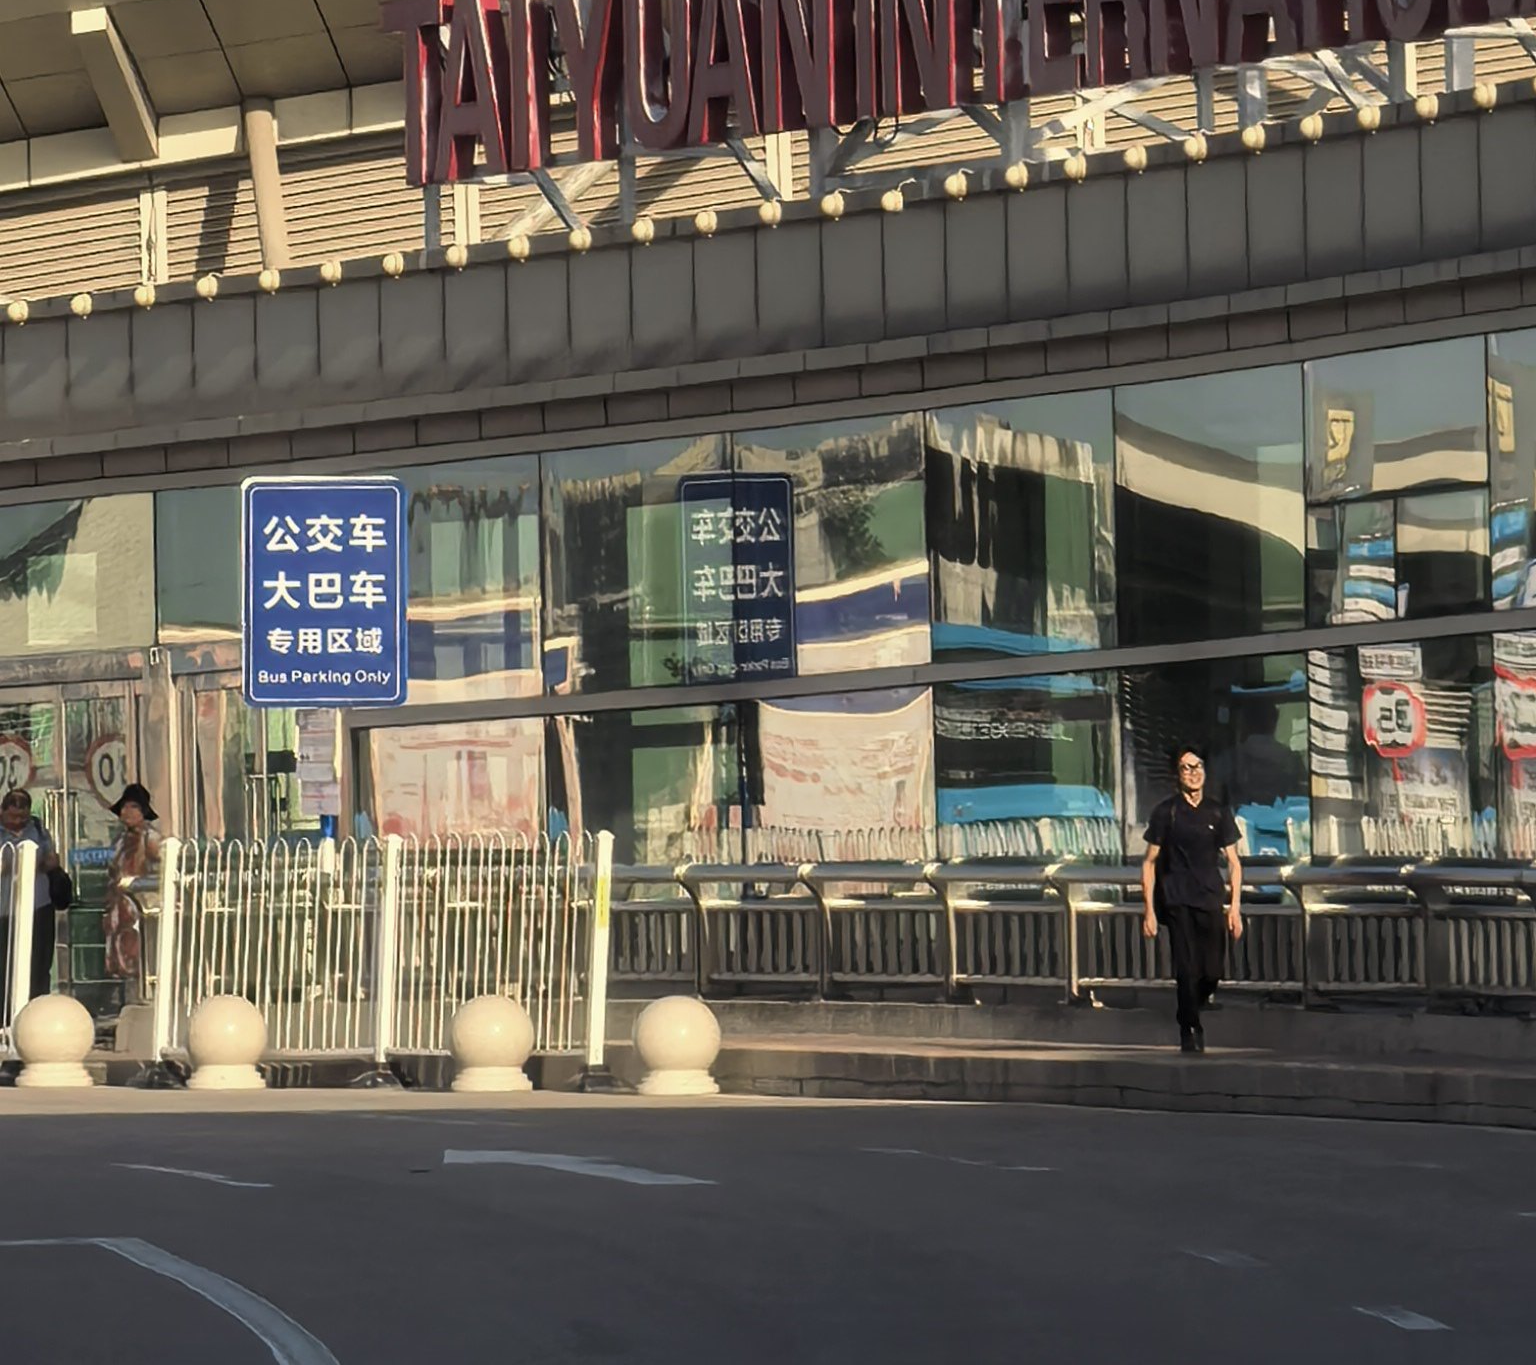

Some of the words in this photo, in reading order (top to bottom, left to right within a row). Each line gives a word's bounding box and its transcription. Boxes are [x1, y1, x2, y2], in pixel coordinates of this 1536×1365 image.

[263, 513, 388, 554] 公交车
[262, 570, 387, 610] 大巴车
[266, 627, 383, 655] 专用区域
[258, 669, 288, 684] Bus
[291, 669, 351, 686] Parking
[355, 669, 391, 685] Only
